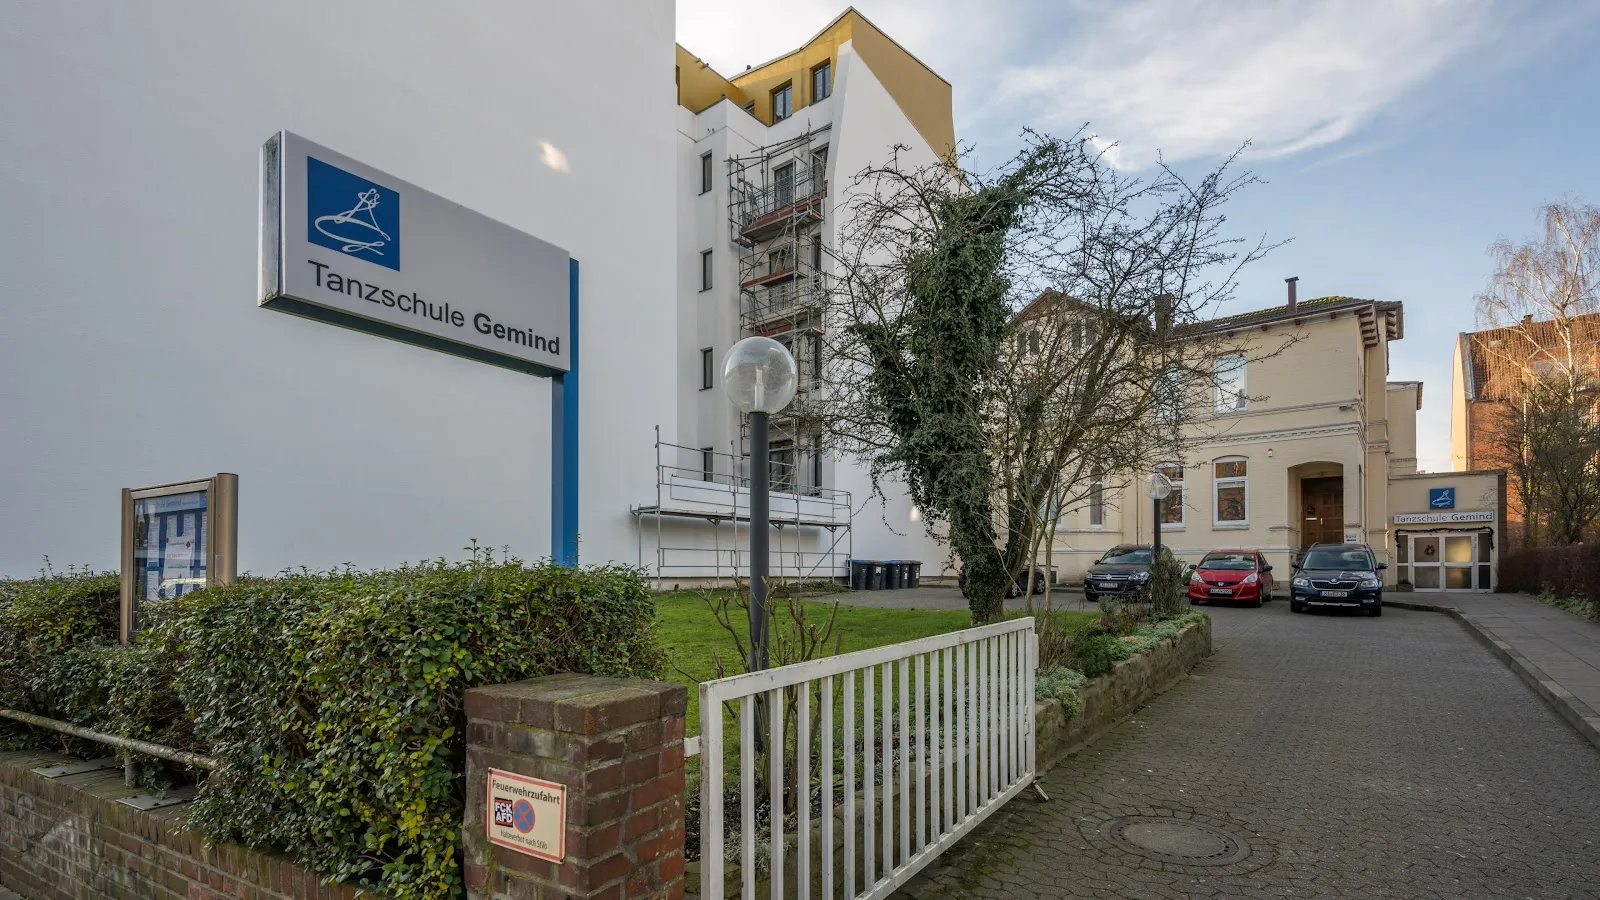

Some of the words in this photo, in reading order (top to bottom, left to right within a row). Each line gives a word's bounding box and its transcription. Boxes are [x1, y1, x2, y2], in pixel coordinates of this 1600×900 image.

[308, 260, 465, 328] Tanzschule
[473, 312, 560, 356] Gemind
[1396, 514, 1447, 523] Tanzschule
[1451, 512, 1493, 521] Gemind
[492, 779, 560, 804] Feuerwehrzufahrt
[495, 802, 512, 813] FCK
[496, 811, 512, 822] AFD
[525, 838, 536, 847] nach
